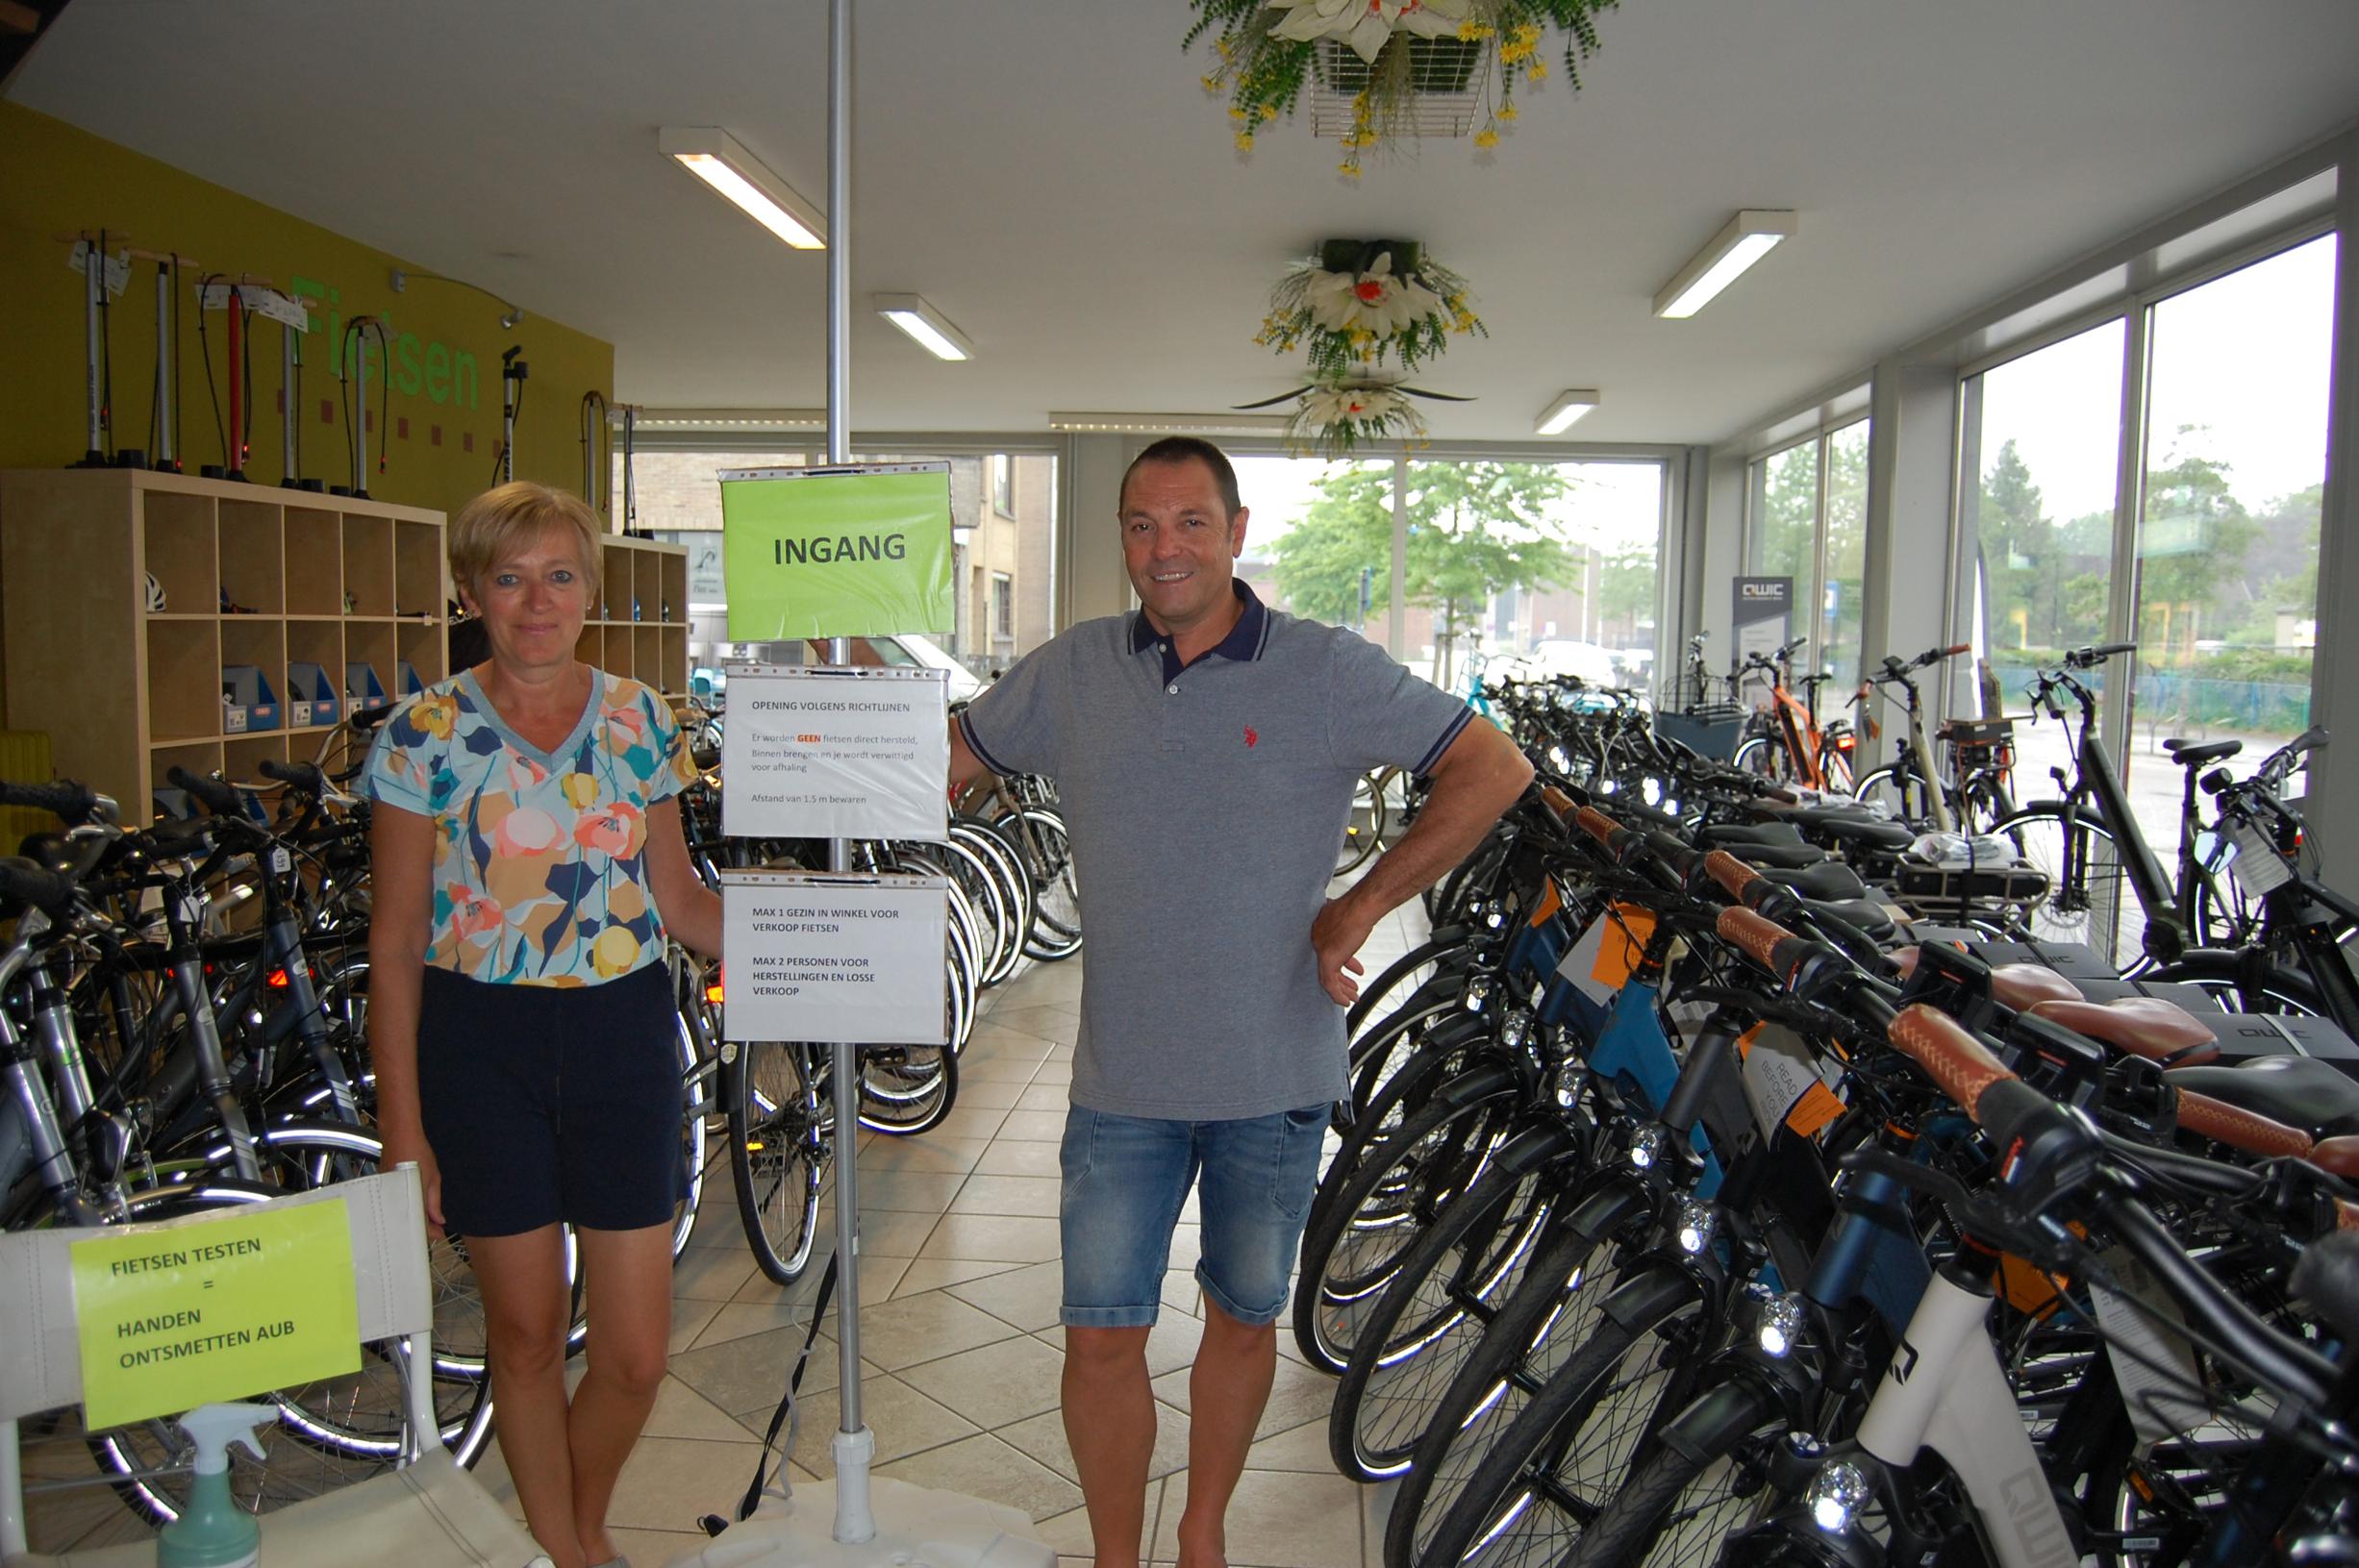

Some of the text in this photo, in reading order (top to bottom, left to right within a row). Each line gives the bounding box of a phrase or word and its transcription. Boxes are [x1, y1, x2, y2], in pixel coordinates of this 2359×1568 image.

[291, 275, 478, 411] Fietsen
[774, 533, 906, 565] INGANG
[1743, 584, 1784, 596] QWIC
[751, 701, 911, 712] OPENING VOLGENS RICHTLIJNEN
[752, 734, 761, 742] Er
[763, 734, 795, 742] worden
[797, 734, 821, 743] GEEN
[823, 734, 852, 744] fietsen
[854, 734, 879, 744] direct
[752, 750, 781, 759] Binnen
[784, 750, 817, 760] brengen
[833, 751, 841, 761] je
[843, 751, 868, 759] wordt
[871, 751, 914, 761] verwittigd
[773, 762, 807, 773] afhaling
[751, 794, 785, 804] Afstand
[829, 795, 866, 805] bewaren
[752, 908, 900, 919] MAX 1 GEZIN IN WINKEL VOOR
[753, 923, 840, 933] VERKOOP FIETSEN
[753, 957, 869, 967] MAX 2 PERSONEN VOOR
[753, 972, 875, 983] HERSTELLINGEN EN LOSSE
[753, 986, 799, 996] VERKOOP
[1761, 1060, 1789, 1108] BEFORE
[1776, 1062, 1798, 1096] READ
[111, 1238, 262, 1277] FIETSEN TESTEN
[117, 1308, 202, 1338] HANDEN
[119, 1320, 295, 1369] ONTSMETTEN AUB
